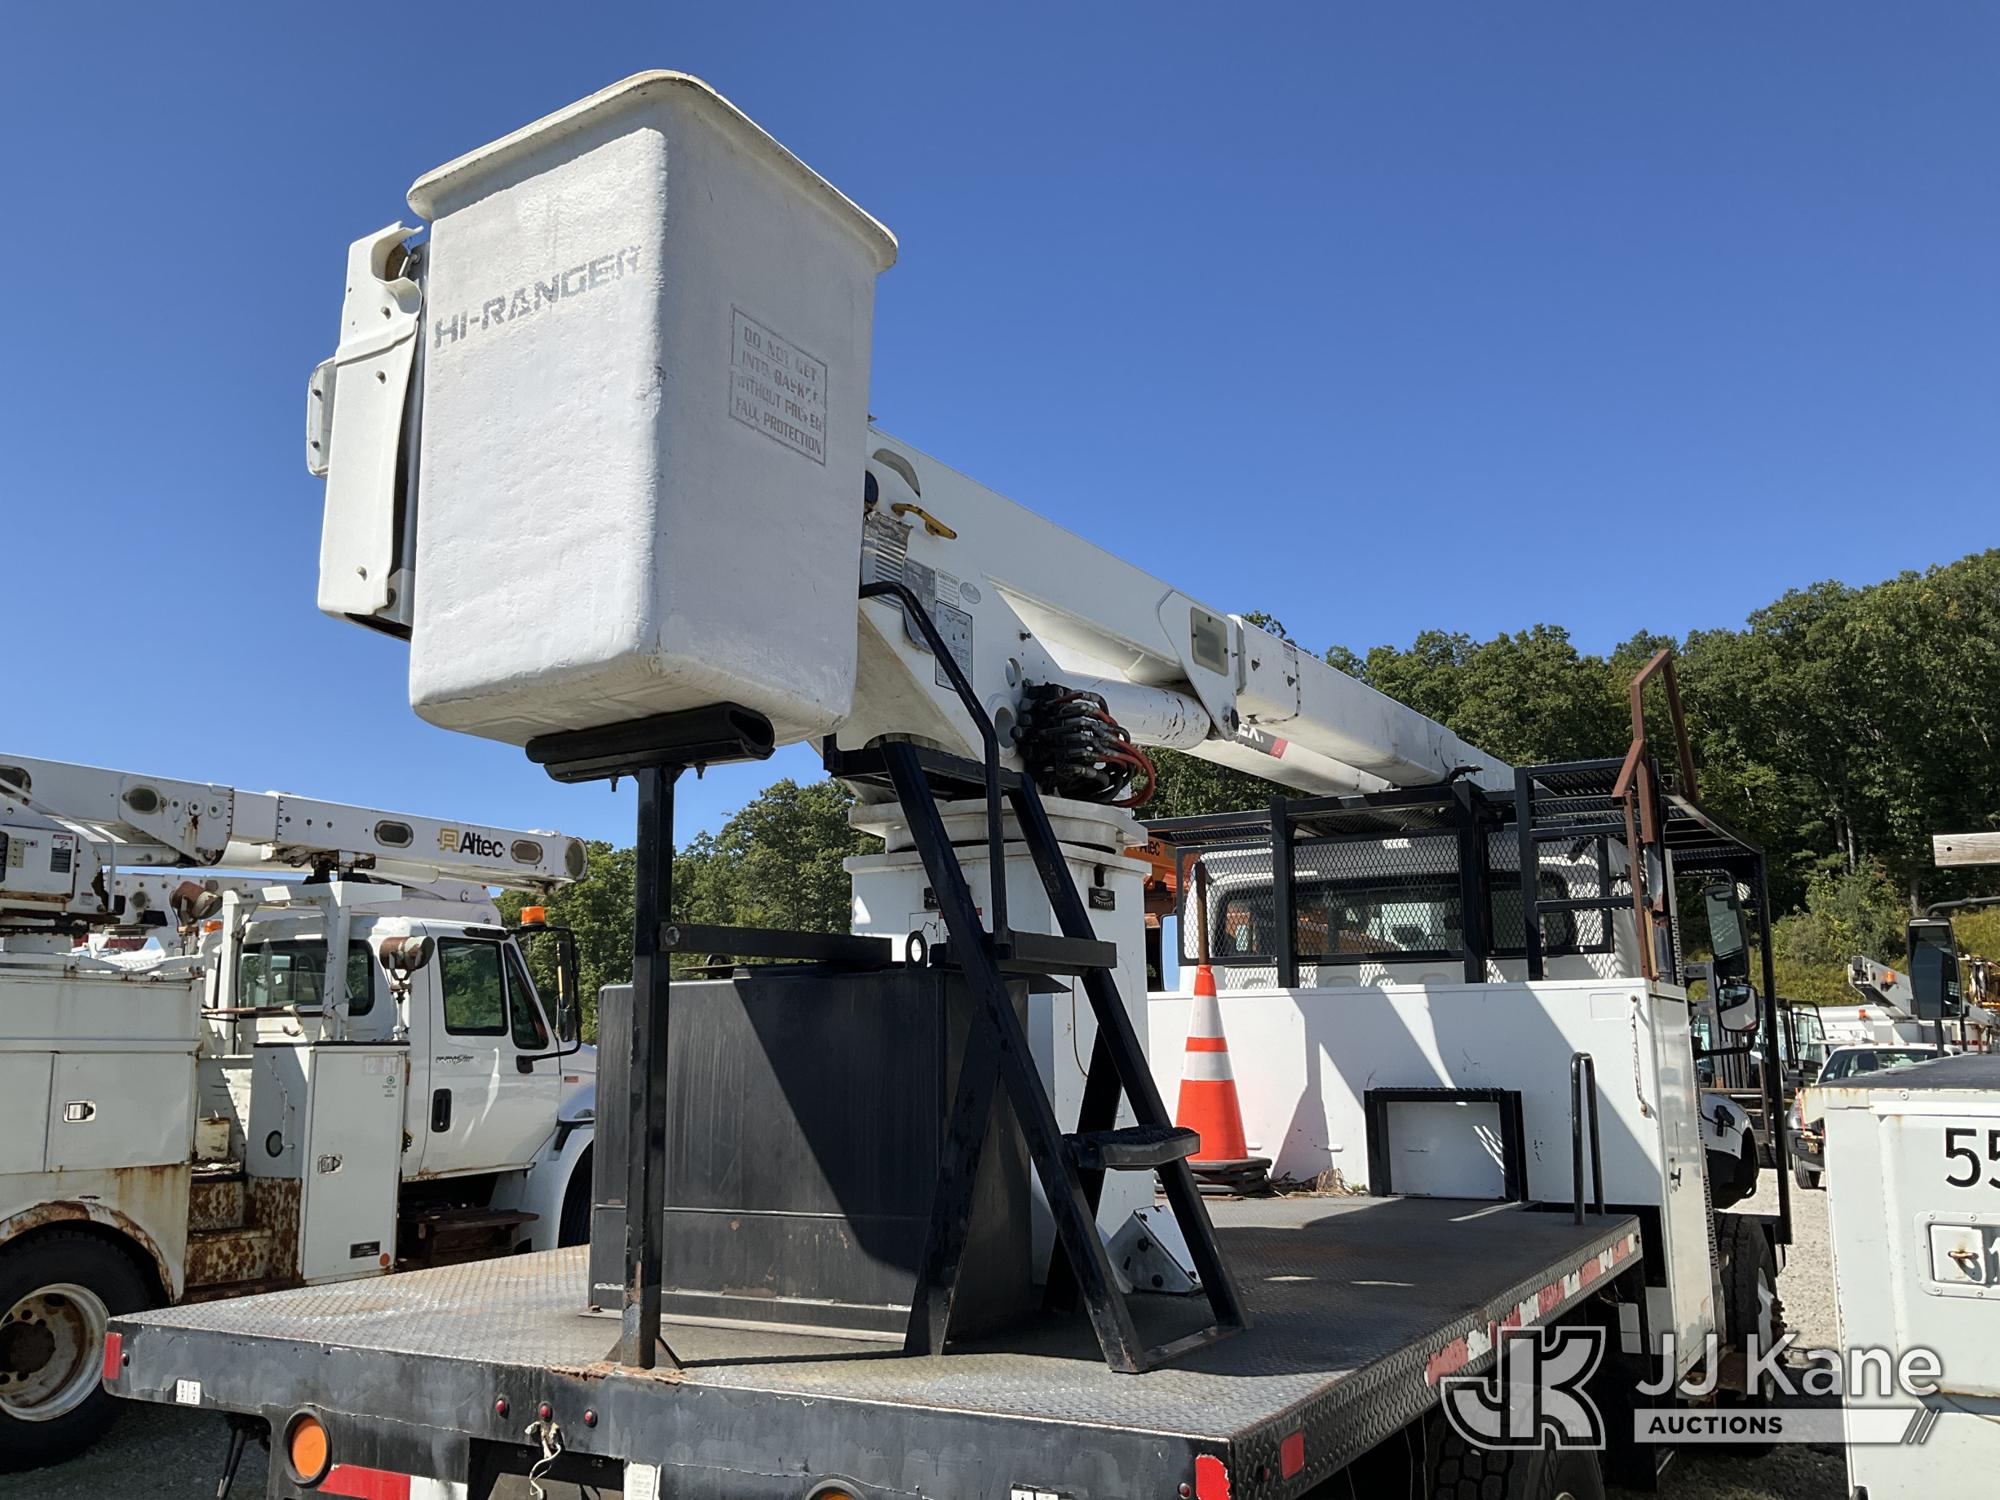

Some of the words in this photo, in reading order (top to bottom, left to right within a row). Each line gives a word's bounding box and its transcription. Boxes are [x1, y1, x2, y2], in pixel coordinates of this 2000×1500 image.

[434, 245, 642, 349] HI-RANGER
[744, 326, 761, 349] DO
[742, 350, 769, 377] INTO
[735, 396, 760, 423] FALL
[764, 412, 821, 455] PROTECTION
[458, 831, 504, 858] Altec
